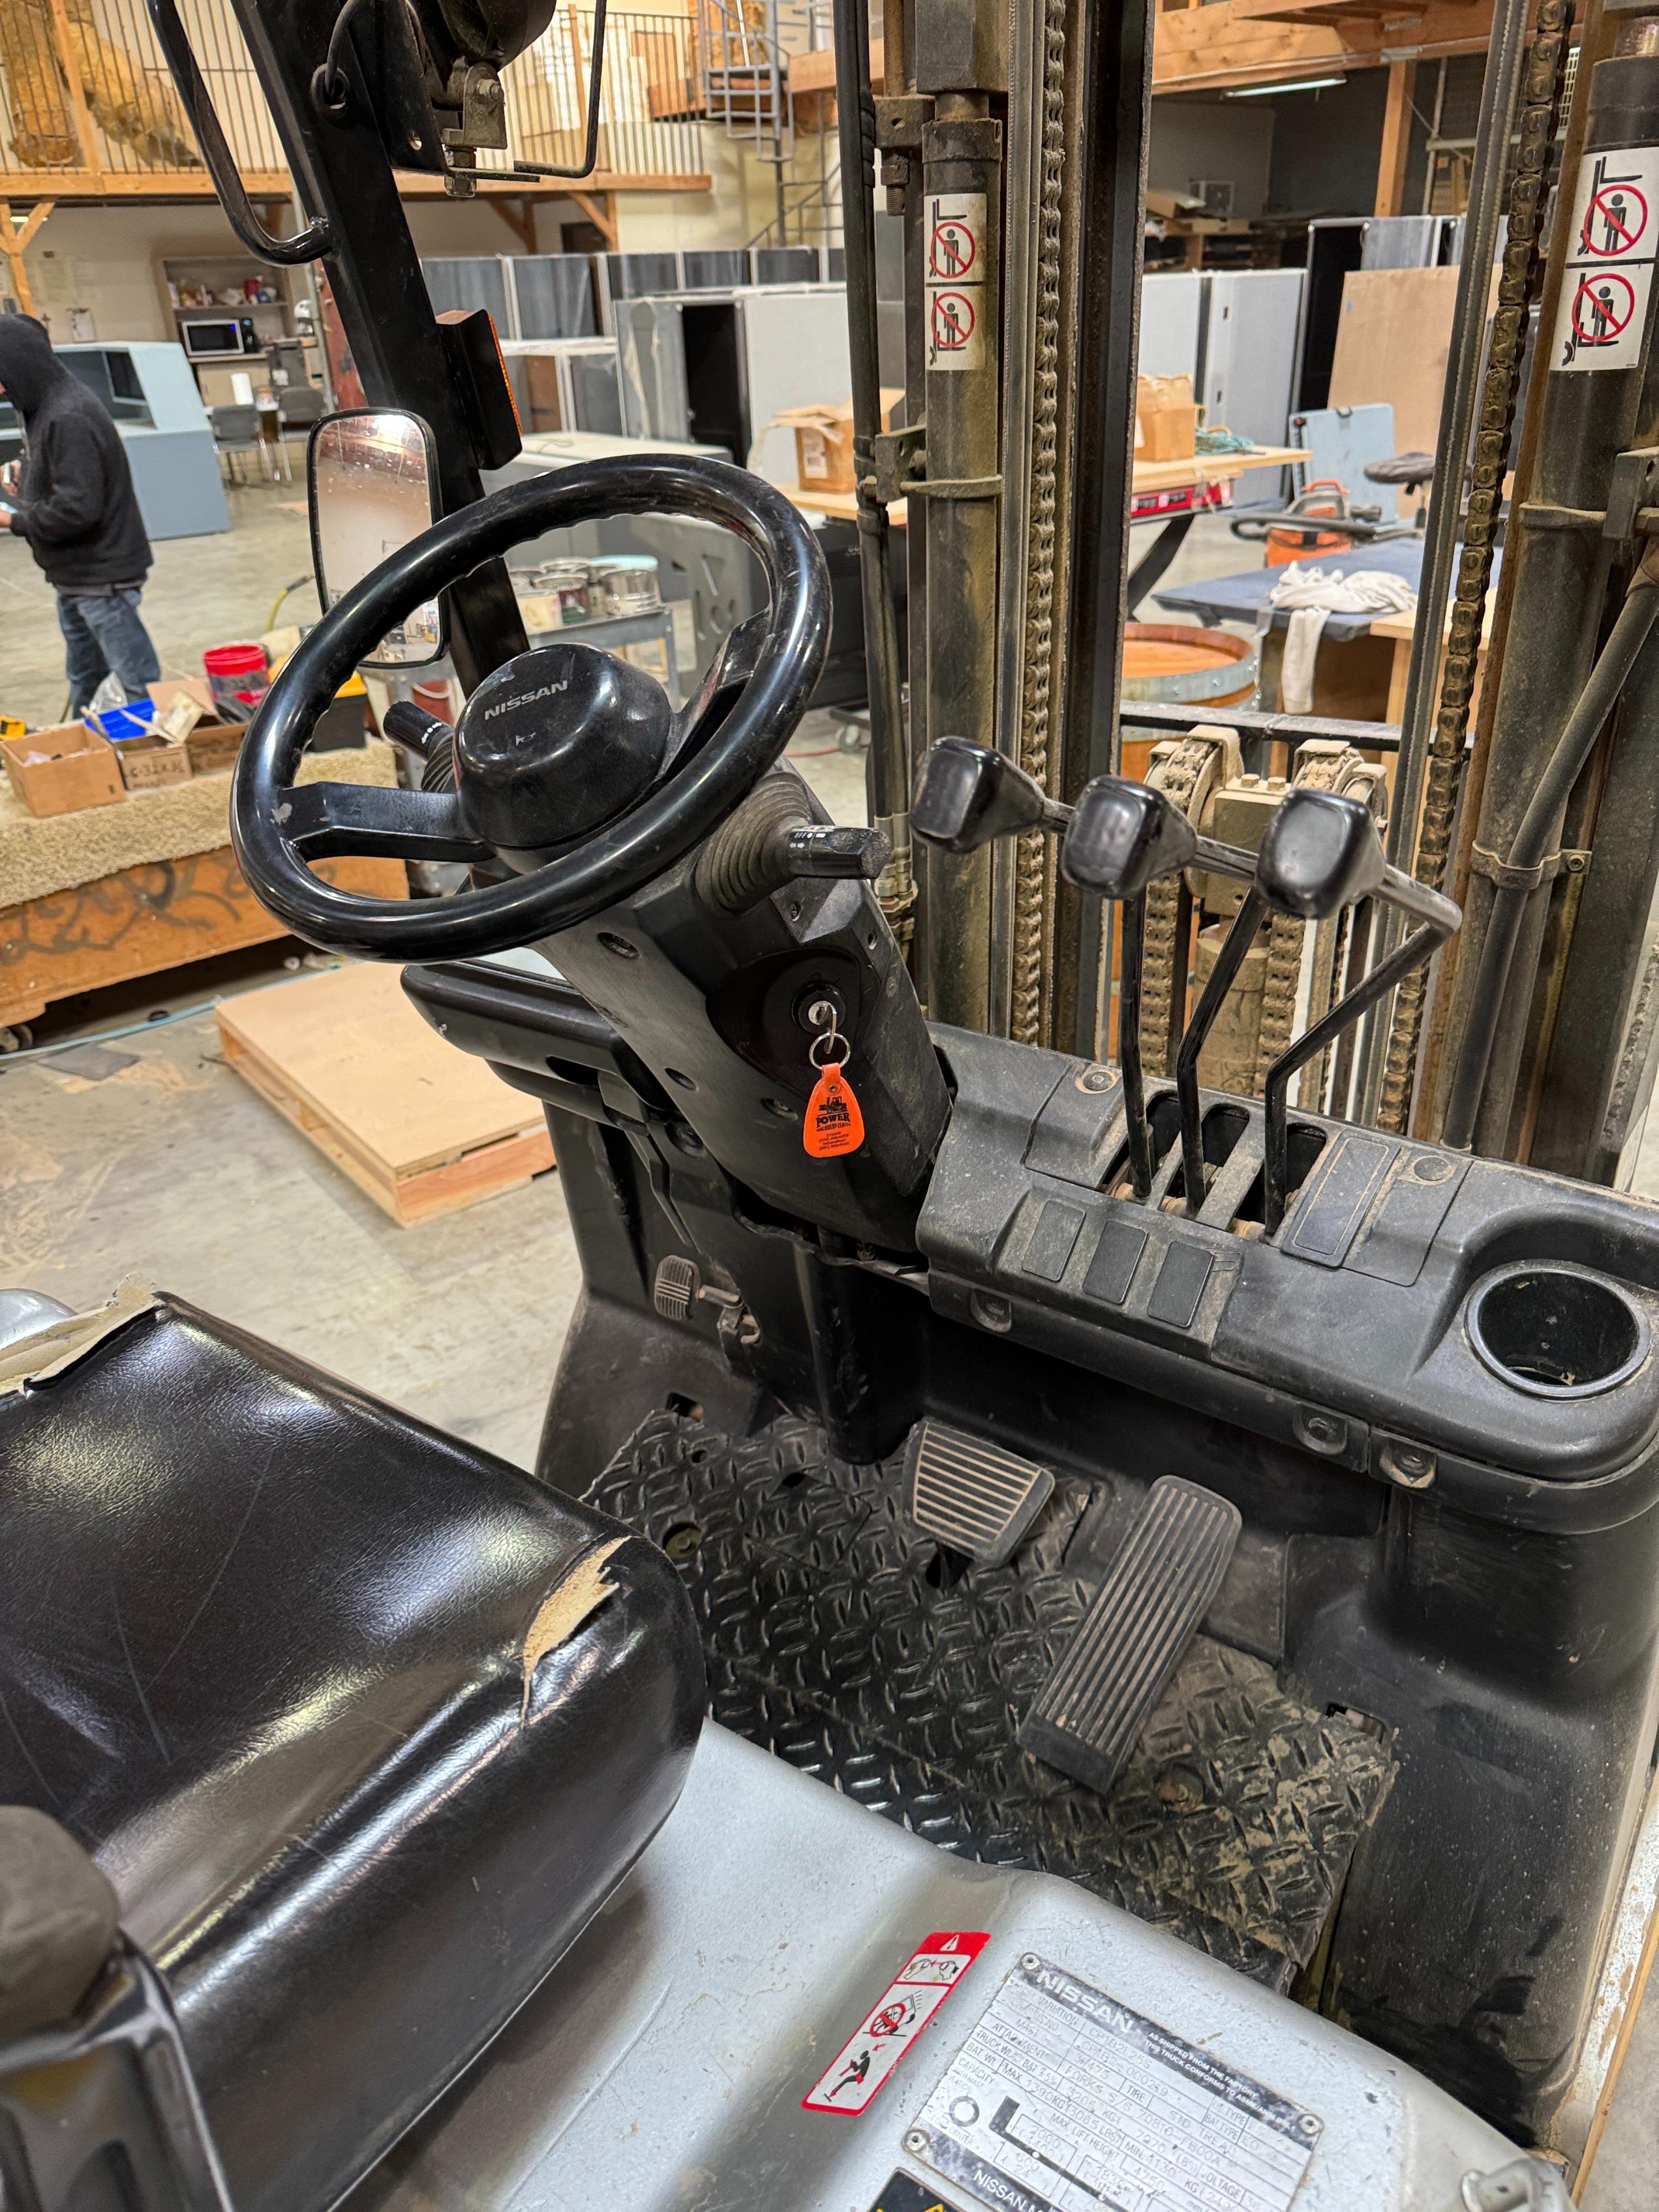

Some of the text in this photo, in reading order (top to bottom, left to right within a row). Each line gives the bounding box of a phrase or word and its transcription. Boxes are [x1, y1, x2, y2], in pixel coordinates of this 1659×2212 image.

[484, 680, 568, 721] NISSAN
[815, 1113, 851, 1128] POWER
[1035, 1968, 1134, 2034] NISSAN
[974, 2029, 1002, 2051] TRUCK
[1014, 2017, 1041, 2038] MAST
[956, 2055, 996, 2085] CAPACITY
[1143, 2039, 1161, 2053] THIS
[1159, 2048, 1185, 2067] TRUCK
[1183, 2063, 1226, 2091] CONFORMS
[1224, 2086, 1237, 2097] TO
[1147, 2031, 1160, 2042] AS
[1157, 2037, 1189, 2059] SHIPPED
[1187, 2054, 1210, 2071] FROM
[1208, 2067, 1225, 2080] THE
[1063, 2065, 1105, 2096] FORKS
[1124, 2084, 1148, 2104] TIRE
[1063, 2085, 1097, 2112] 3205
[1133, 2127, 1168, 2154] 7070
[1217, 2121, 1241, 2140] TYPE
[1223, 2106, 1247, 2127] TYPE
[947, 2125, 975, 2147] CENTER
[1028, 2124, 1061, 2149] 2000
[1049, 2112, 1120, 2162] MAX LIFT HEIGHT
[1196, 2128, 1238, 2159] TREAD
[1014, 2151, 1041, 2173] 600
[973, 2168, 1029, 2212] NISSAN
[1131, 2164, 1166, 2192] 4750
